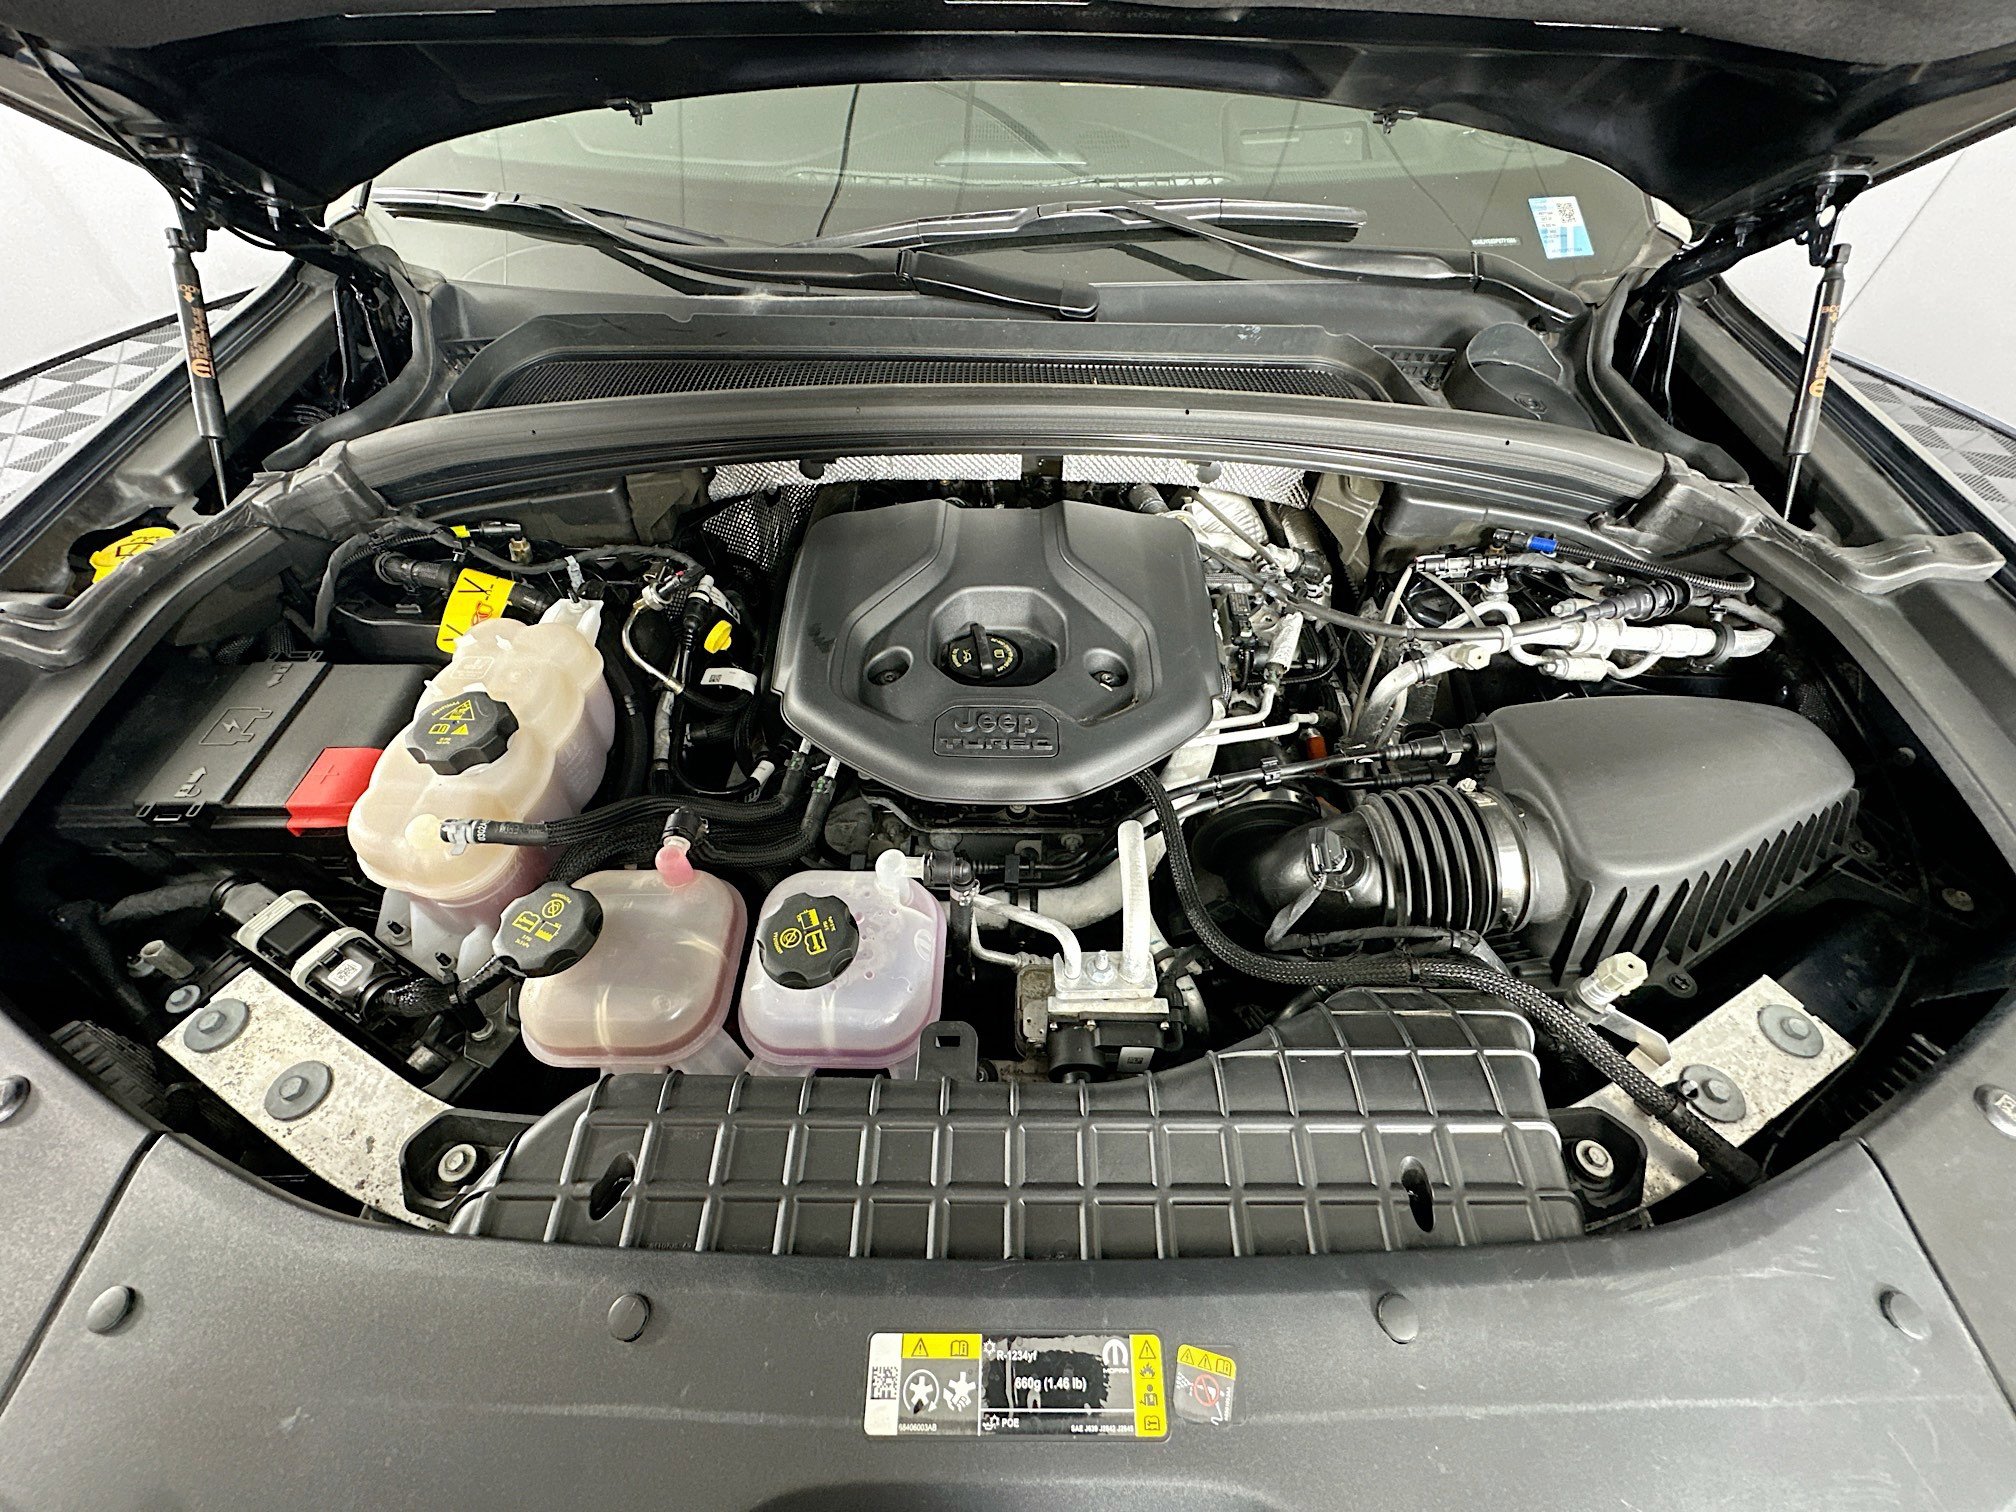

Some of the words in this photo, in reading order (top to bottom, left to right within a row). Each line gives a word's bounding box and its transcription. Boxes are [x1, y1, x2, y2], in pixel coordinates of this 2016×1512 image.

[954, 707, 1039, 738] Jeep
[939, 738, 1053, 750] TURBO
[996, 1349, 1038, 1364] R-1234yf
[1014, 1376, 1042, 1392] 660g
[1043, 1376, 1070, 1392] (1.46
[1072, 1376, 1088, 1392] lb)
[1001, 1417, 1020, 1428] POE
[1070, 1424, 1084, 1433] SAE
